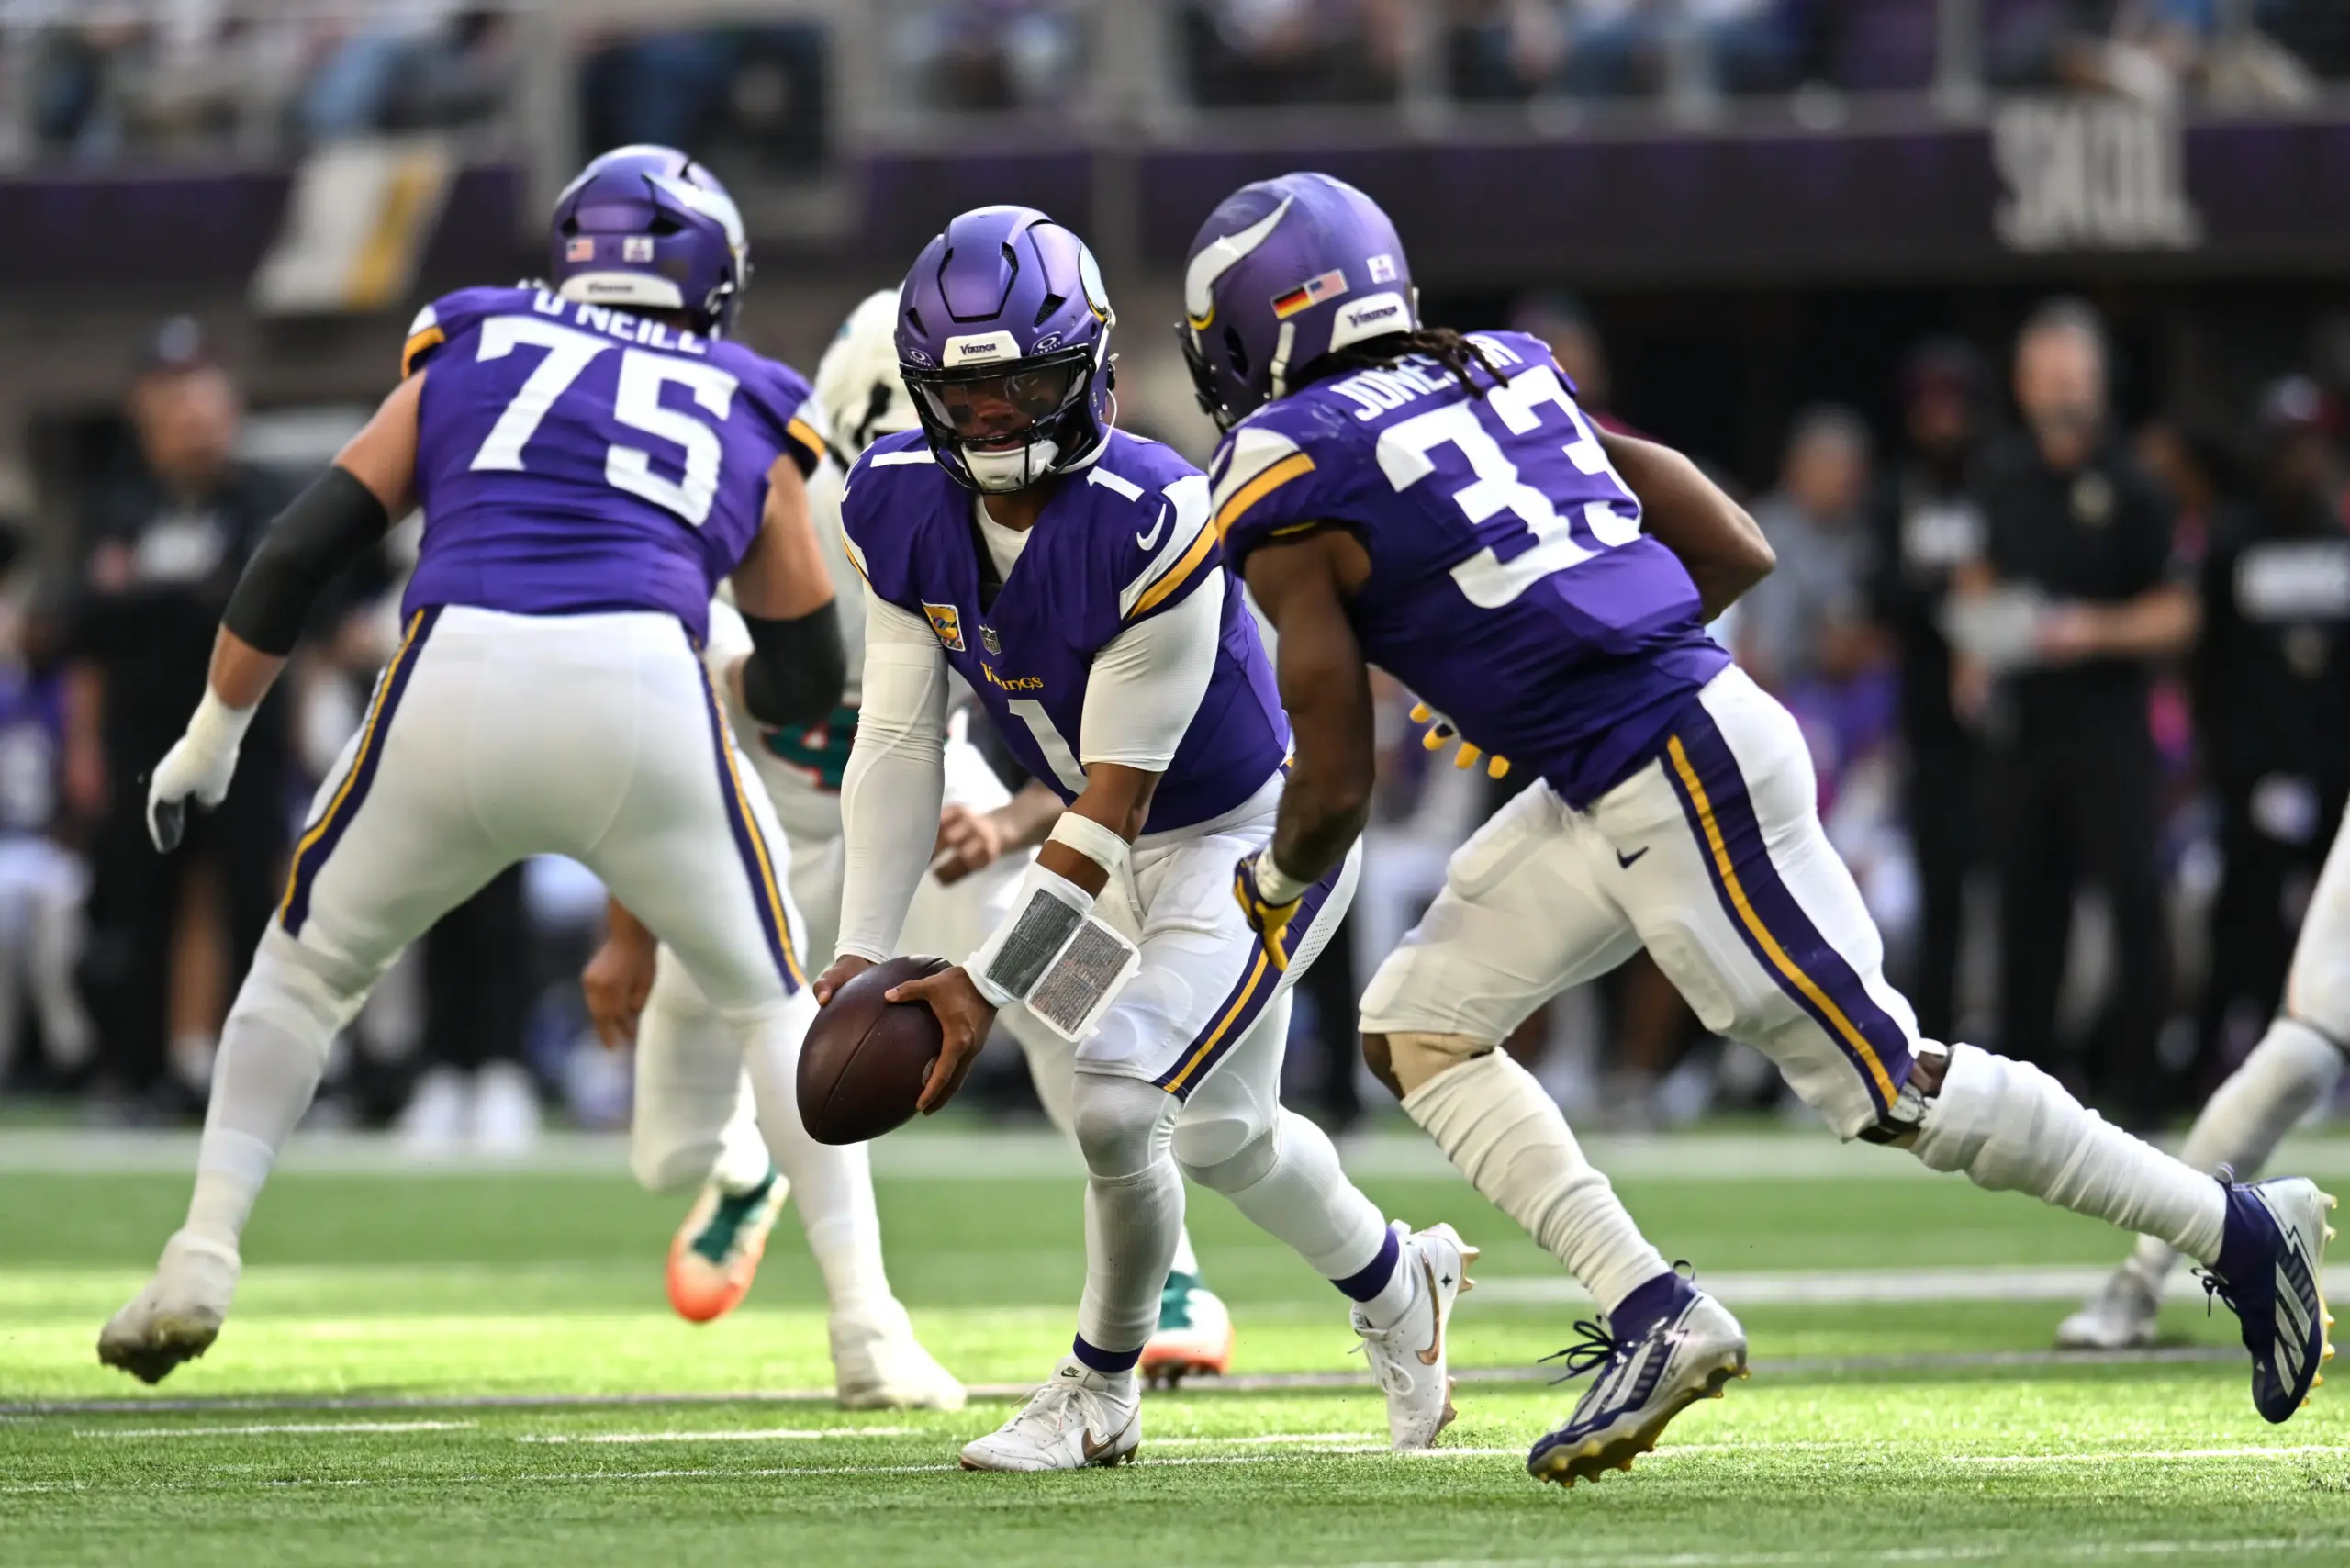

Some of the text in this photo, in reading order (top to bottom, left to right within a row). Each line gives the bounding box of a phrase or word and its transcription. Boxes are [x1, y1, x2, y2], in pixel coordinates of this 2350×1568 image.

[469, 316, 739, 526] 75
[1087, 466, 1145, 502] 1
[1377, 365, 1642, 608] 33
[1008, 699, 1090, 798] 1
